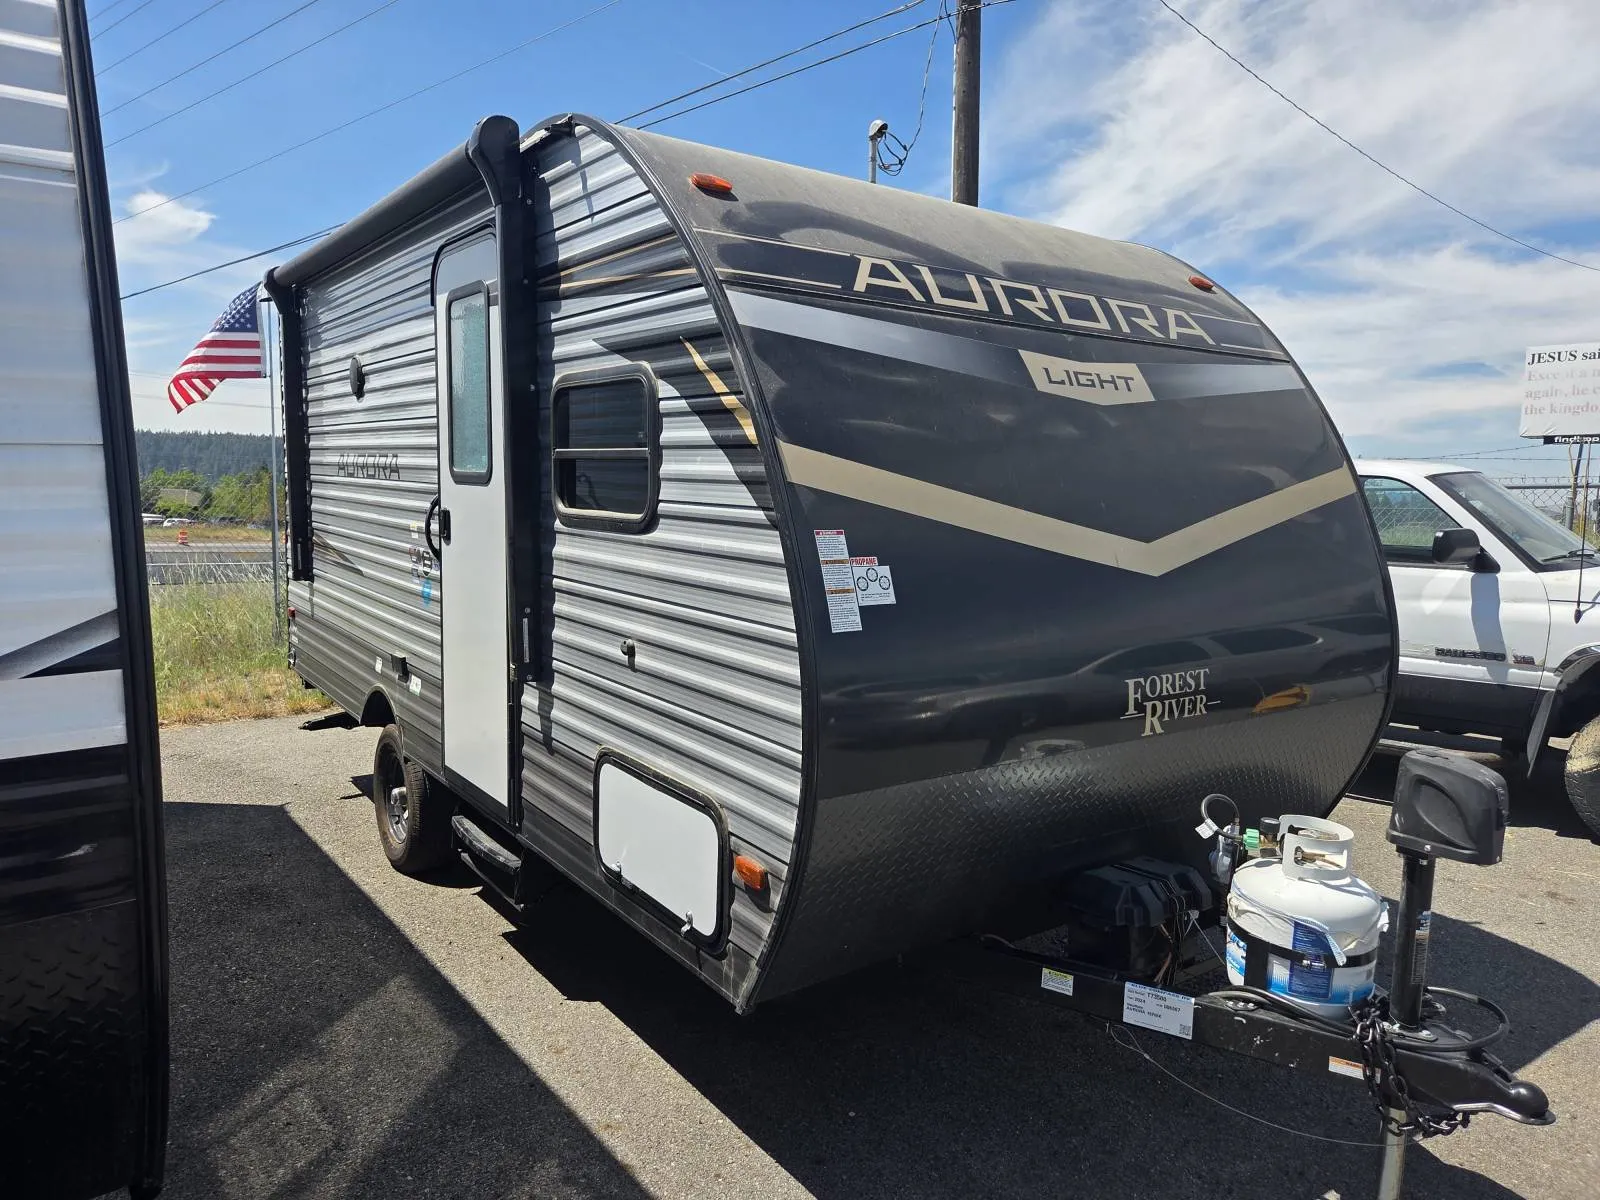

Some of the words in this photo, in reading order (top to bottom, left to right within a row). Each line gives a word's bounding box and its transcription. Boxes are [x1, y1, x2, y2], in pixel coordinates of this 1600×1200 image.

[853, 256, 1216, 345] AURORA
[1528, 350, 1578, 366] JESUS
[1042, 367, 1135, 393] LIGHT
[1524, 402, 1546, 416] the
[1549, 401, 1600, 416] kingdo
[337, 453, 401, 480] AURORA
[1124, 668, 1210, 716] FOREST
[1141, 694, 1208, 737] RIVER
